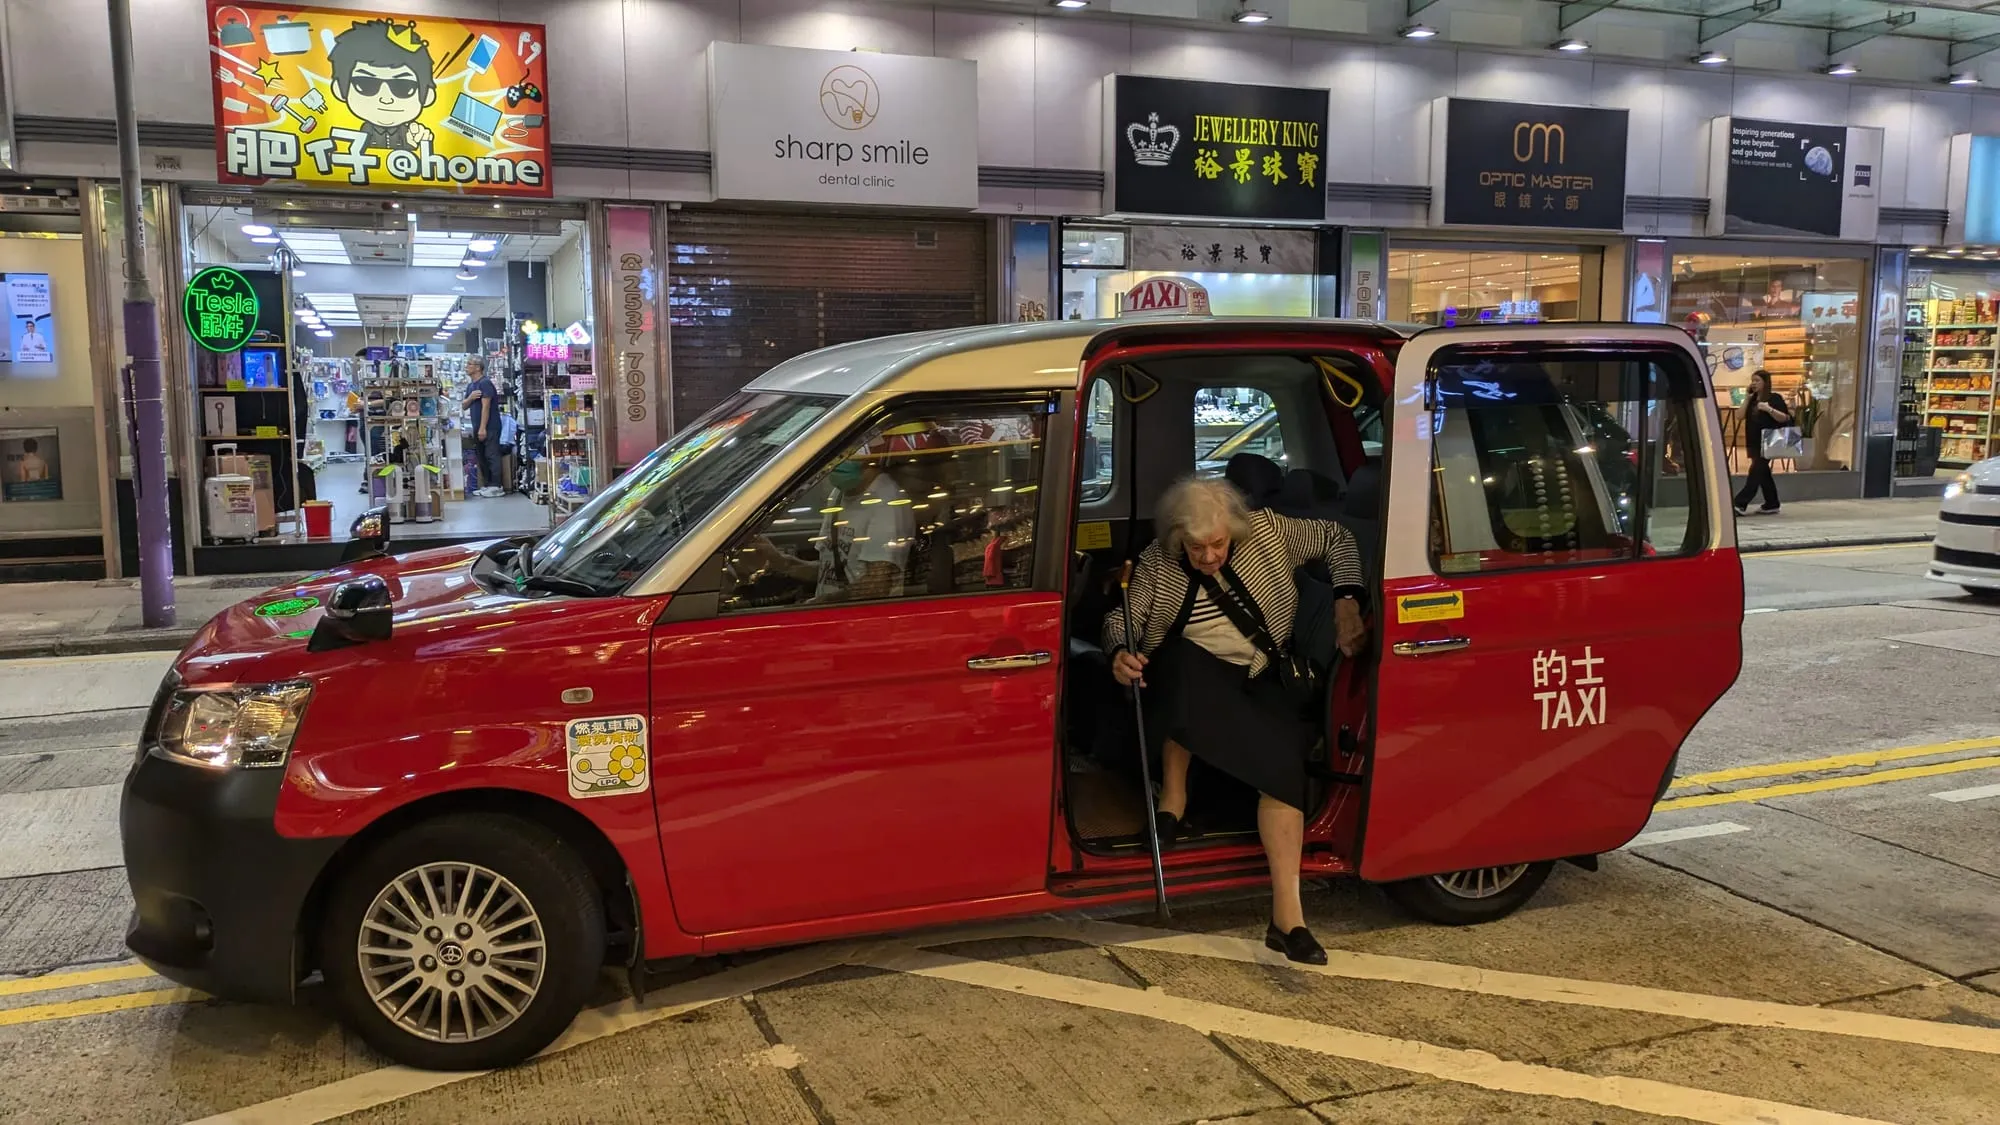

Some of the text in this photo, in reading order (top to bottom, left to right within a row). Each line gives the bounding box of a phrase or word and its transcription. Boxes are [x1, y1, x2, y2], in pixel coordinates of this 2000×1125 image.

[1193, 115, 1319, 148] JEWELLERY KING
[1733, 128, 1795, 139] Inspiring generations
[227, 128, 544, 186] 肥仔 @home
[775, 134, 929, 167] sharp smile
[1744, 150, 1753, 158] go
[1754, 149, 1776, 158] beyond
[818, 173, 895, 188] dental clinic
[1194, 149, 1320, 189] 裕景珠寶
[1480, 172, 1594, 190] OPTIC MASTER
[1494, 191, 1580, 211] 眼鏡大師
[1181, 243, 1273, 265] 裕景珠寶
[191, 288, 257, 315] Tesla
[1130, 281, 1181, 310] TAXI
[200, 313, 244, 339] 配件
[624, 275, 647, 422] 2537 7099
[1532, 645, 1605, 688] 的士
[1533, 687, 1606, 730] TAXI
[600, 778, 618, 786] LPG
